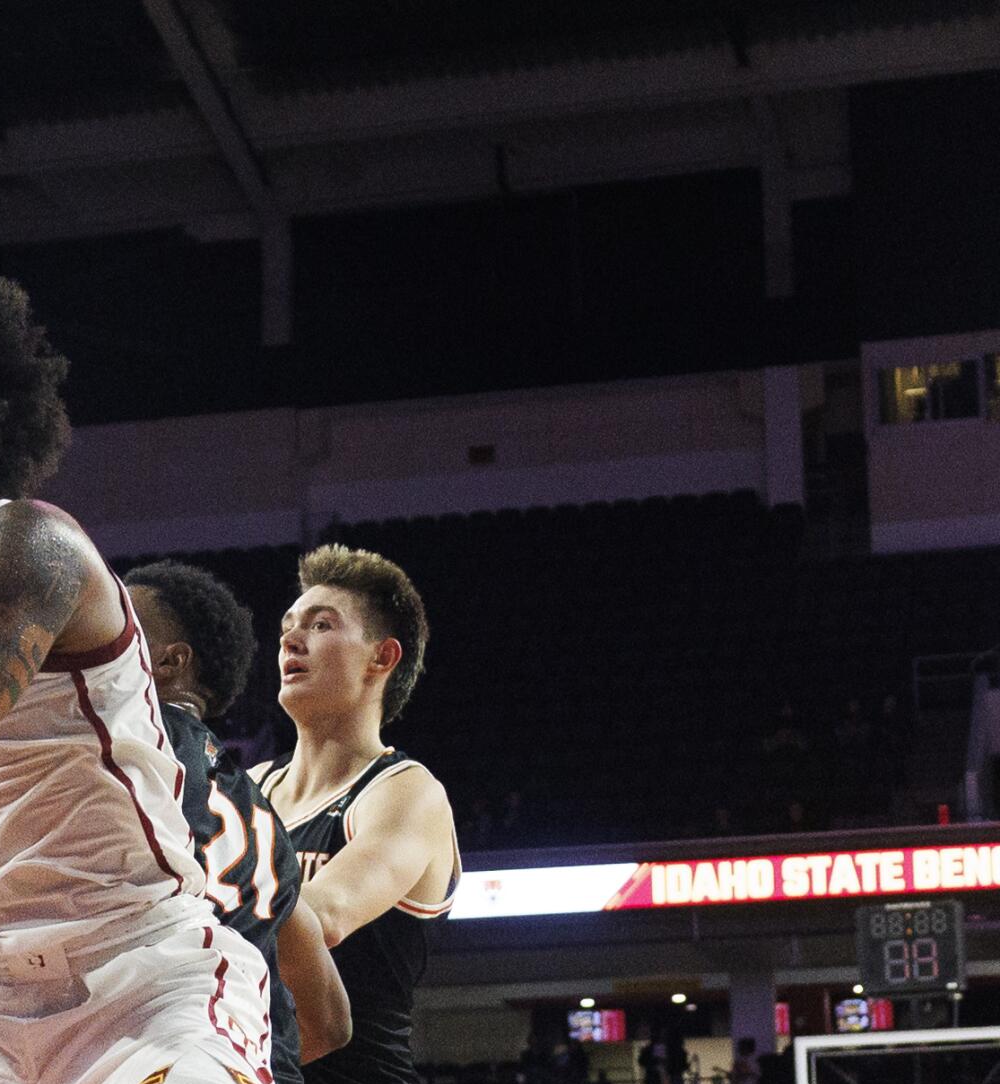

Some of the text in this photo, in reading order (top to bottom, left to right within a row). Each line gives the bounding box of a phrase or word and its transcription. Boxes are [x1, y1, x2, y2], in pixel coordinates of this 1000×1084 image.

[202, 780, 279, 919] 21
[651, 860, 774, 904] IDAHO
[781, 851, 905, 897] STATE
